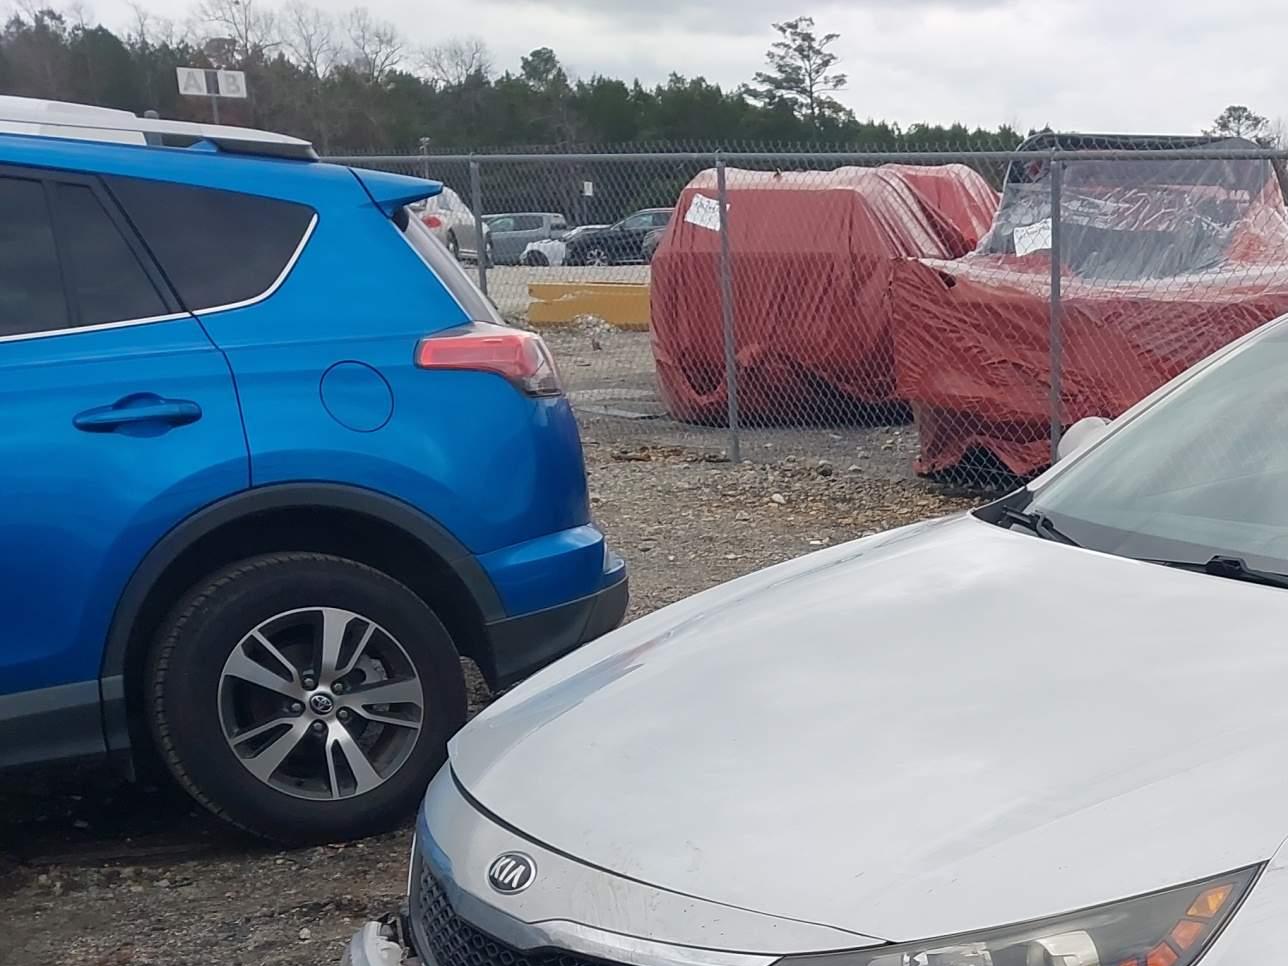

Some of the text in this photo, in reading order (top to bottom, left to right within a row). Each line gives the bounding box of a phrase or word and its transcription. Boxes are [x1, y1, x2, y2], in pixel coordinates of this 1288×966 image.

[183, 71, 202, 92] A
[223, 73, 241, 94] B
[490, 856, 526, 889] KIA
